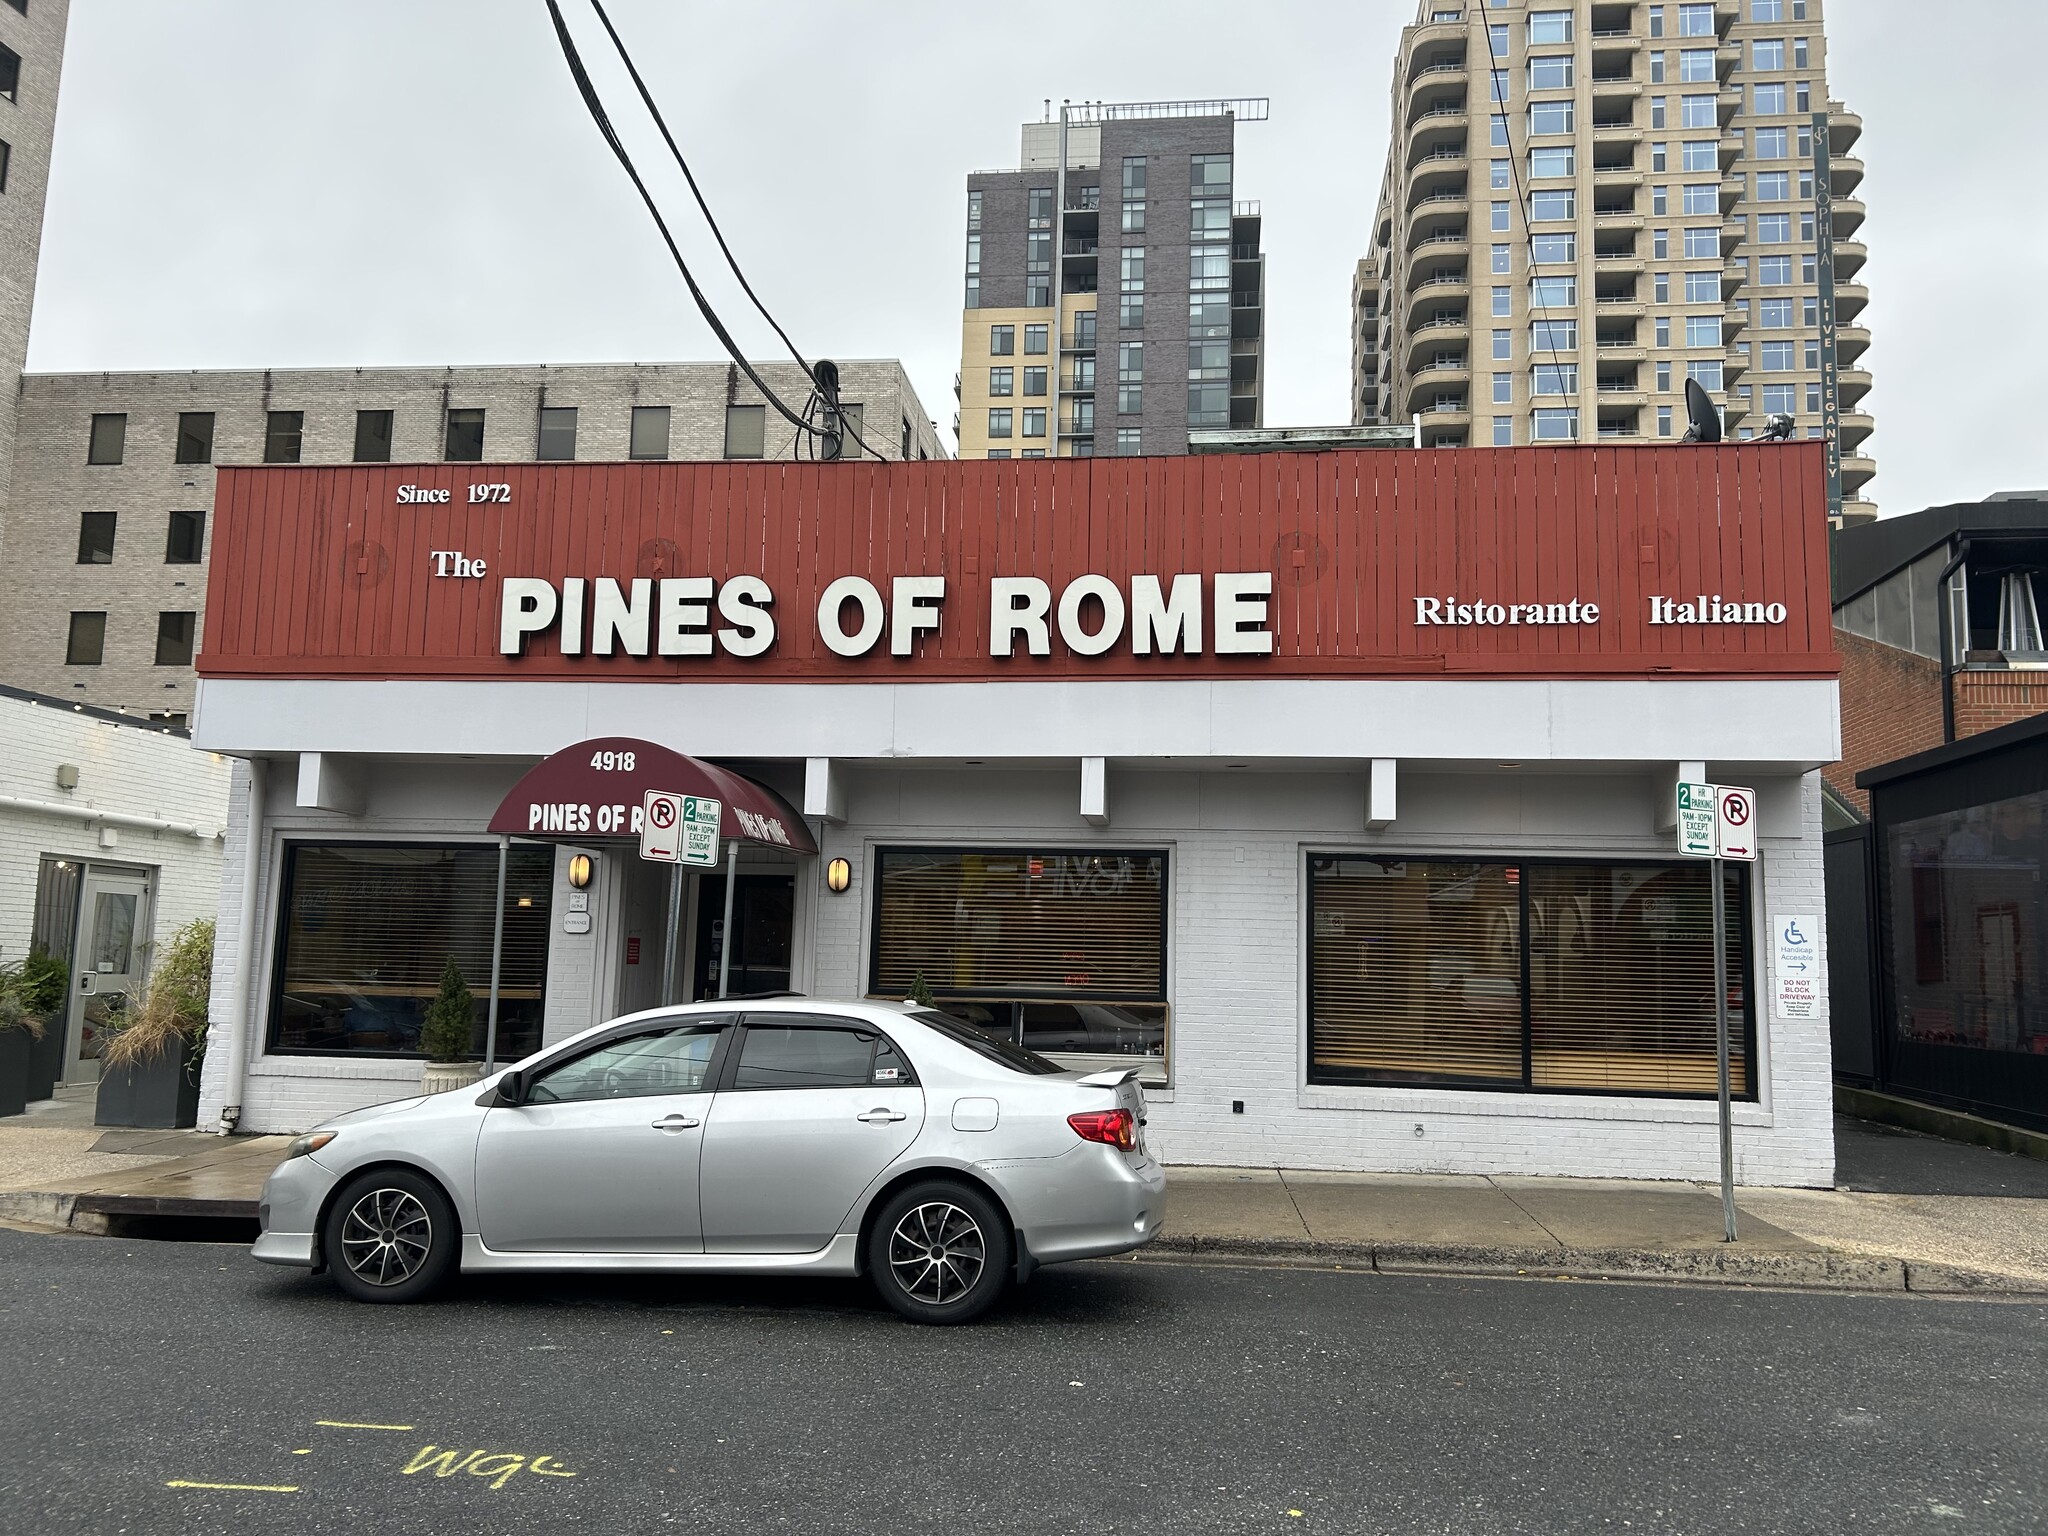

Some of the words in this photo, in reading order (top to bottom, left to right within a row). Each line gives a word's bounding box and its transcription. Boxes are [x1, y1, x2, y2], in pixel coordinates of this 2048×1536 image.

[1816, 177, 1831, 266] SOPHIA
[1822, 298, 1833, 348] LIVE
[1825, 362, 1837, 478] ELEGANTLY
[396, 484, 450, 504] Since
[467, 483, 512, 504] 1972
[431, 550, 487, 579] The
[500, 576, 774, 656] PINES
[818, 576, 945, 656] OF
[990, 573, 1273, 657] ROME
[1414, 596, 1599, 625] Ristorante
[1649, 595, 1787, 624] Italiano
[590, 751, 636, 772] 4918
[1680, 787, 1689, 805] 2
[1691, 798, 1713, 810] PARKING
[528, 802, 590, 832] PINES
[596, 804, 626, 833] OF
[686, 801, 695, 818] 2
[696, 811, 717, 823] PARKING
[689, 832, 711, 842] EXCEPT
[1686, 821, 1709, 832] EXCEPT
[1686, 831, 1709, 841] SUNDAY
[688, 840, 711, 852] SUNDAY
